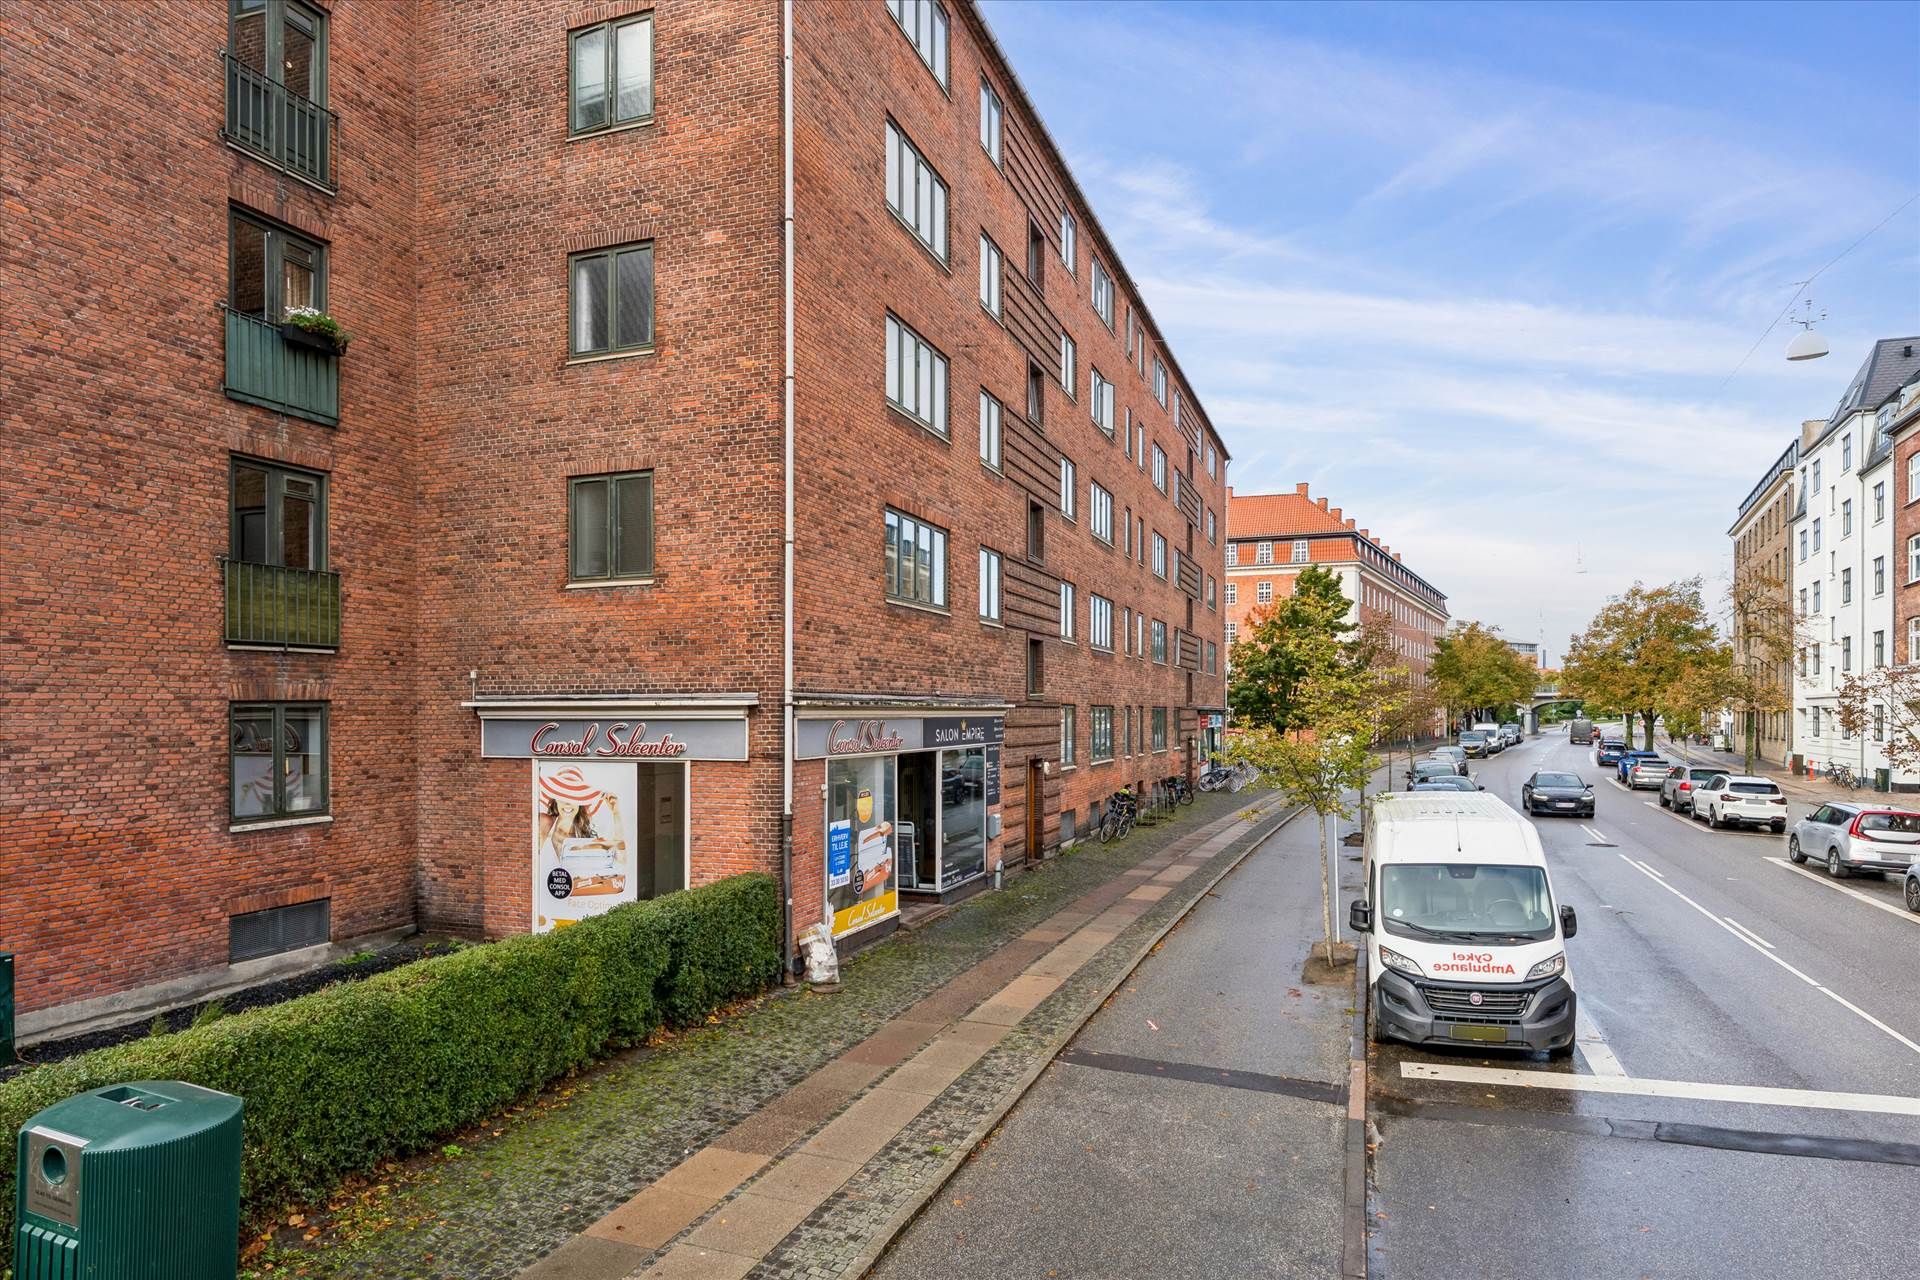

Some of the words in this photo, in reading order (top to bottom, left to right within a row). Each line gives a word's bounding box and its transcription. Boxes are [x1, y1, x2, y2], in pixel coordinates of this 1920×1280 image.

[530, 722, 599, 756] Consol
[595, 722, 687, 757] Solcenter
[827, 720, 867, 754] Consol
[860, 720, 904, 752] Solcenter
[935, 728, 959, 742] SALON
[961, 726, 985, 741] EMPIRE
[549, 883, 571, 891] CONSOL
